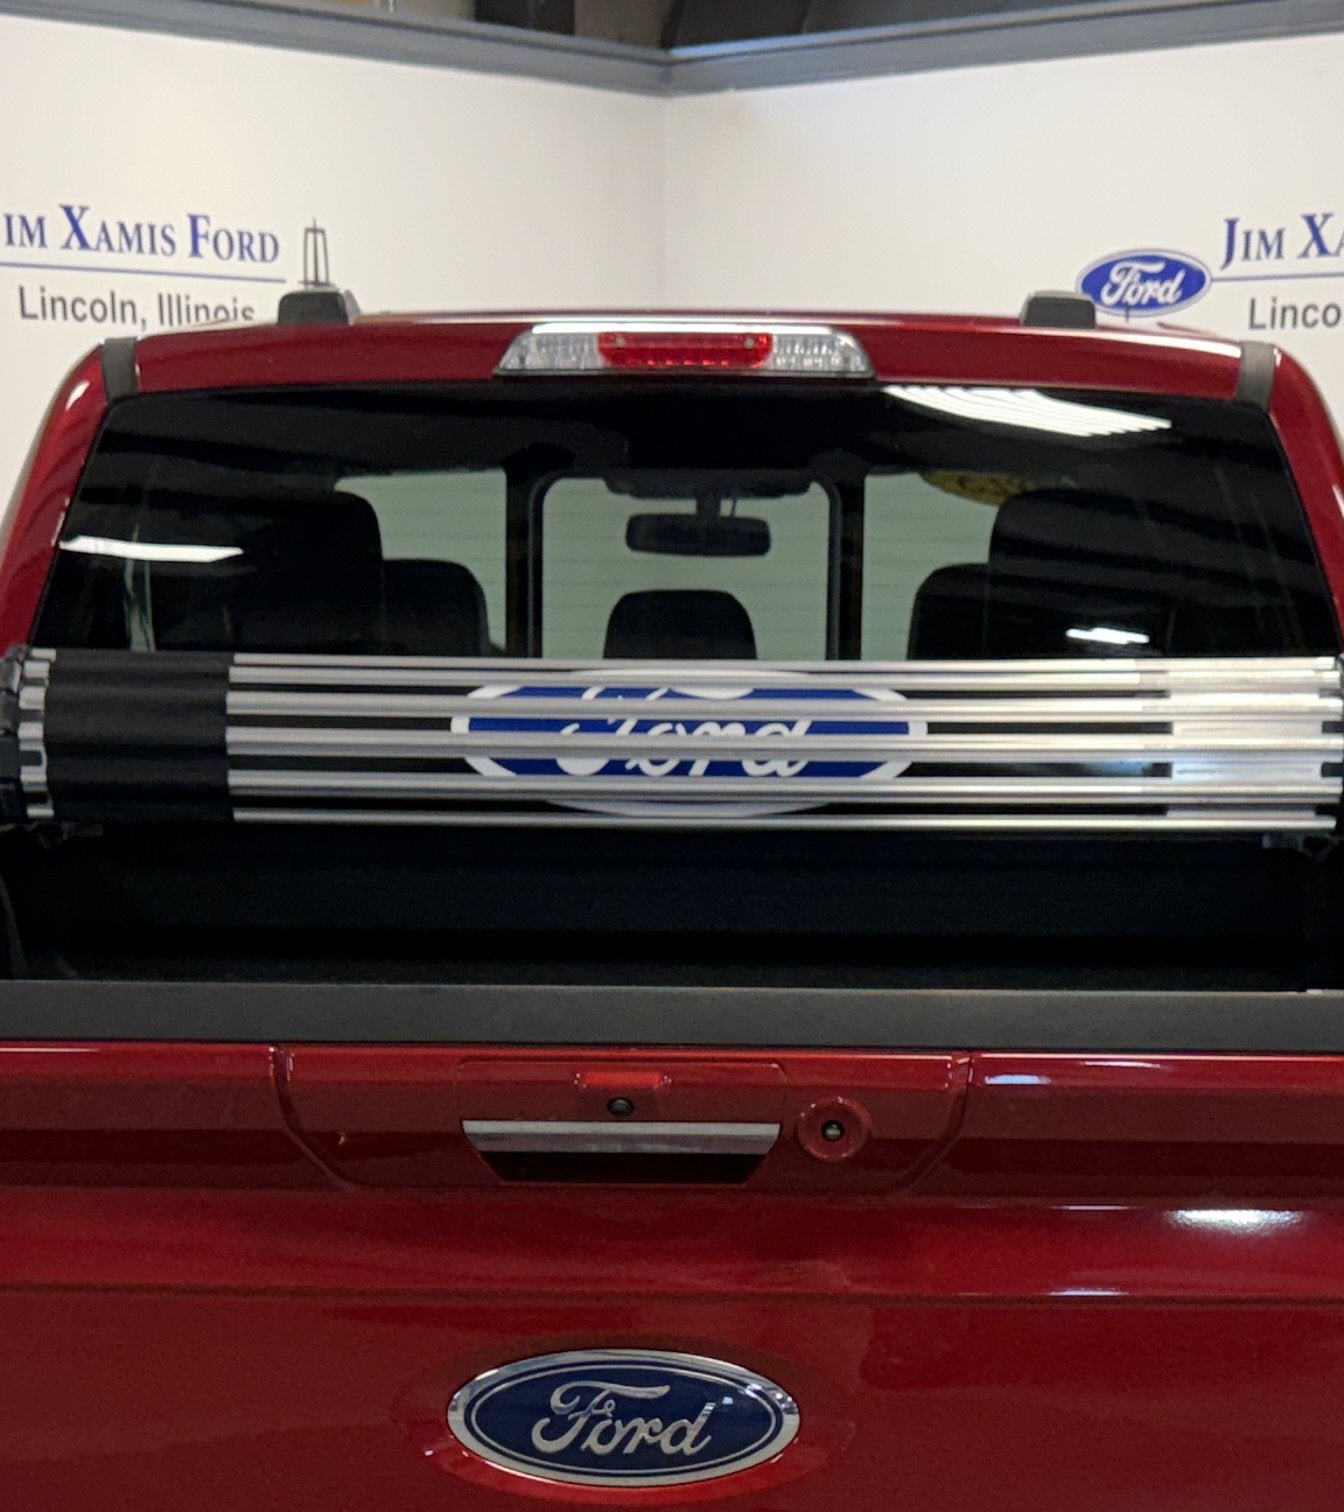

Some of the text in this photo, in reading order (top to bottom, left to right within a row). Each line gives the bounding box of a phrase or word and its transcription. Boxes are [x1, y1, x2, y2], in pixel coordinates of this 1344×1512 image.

[58, 203, 177, 258] XAMIS
[186, 213, 280, 264] FORD
[1219, 217, 1286, 271] JIM
[17, 286, 255, 330] Lincoln, Illinois
[1100, 260, 1184, 307] Ford
[531, 1379, 713, 1456] Ford
